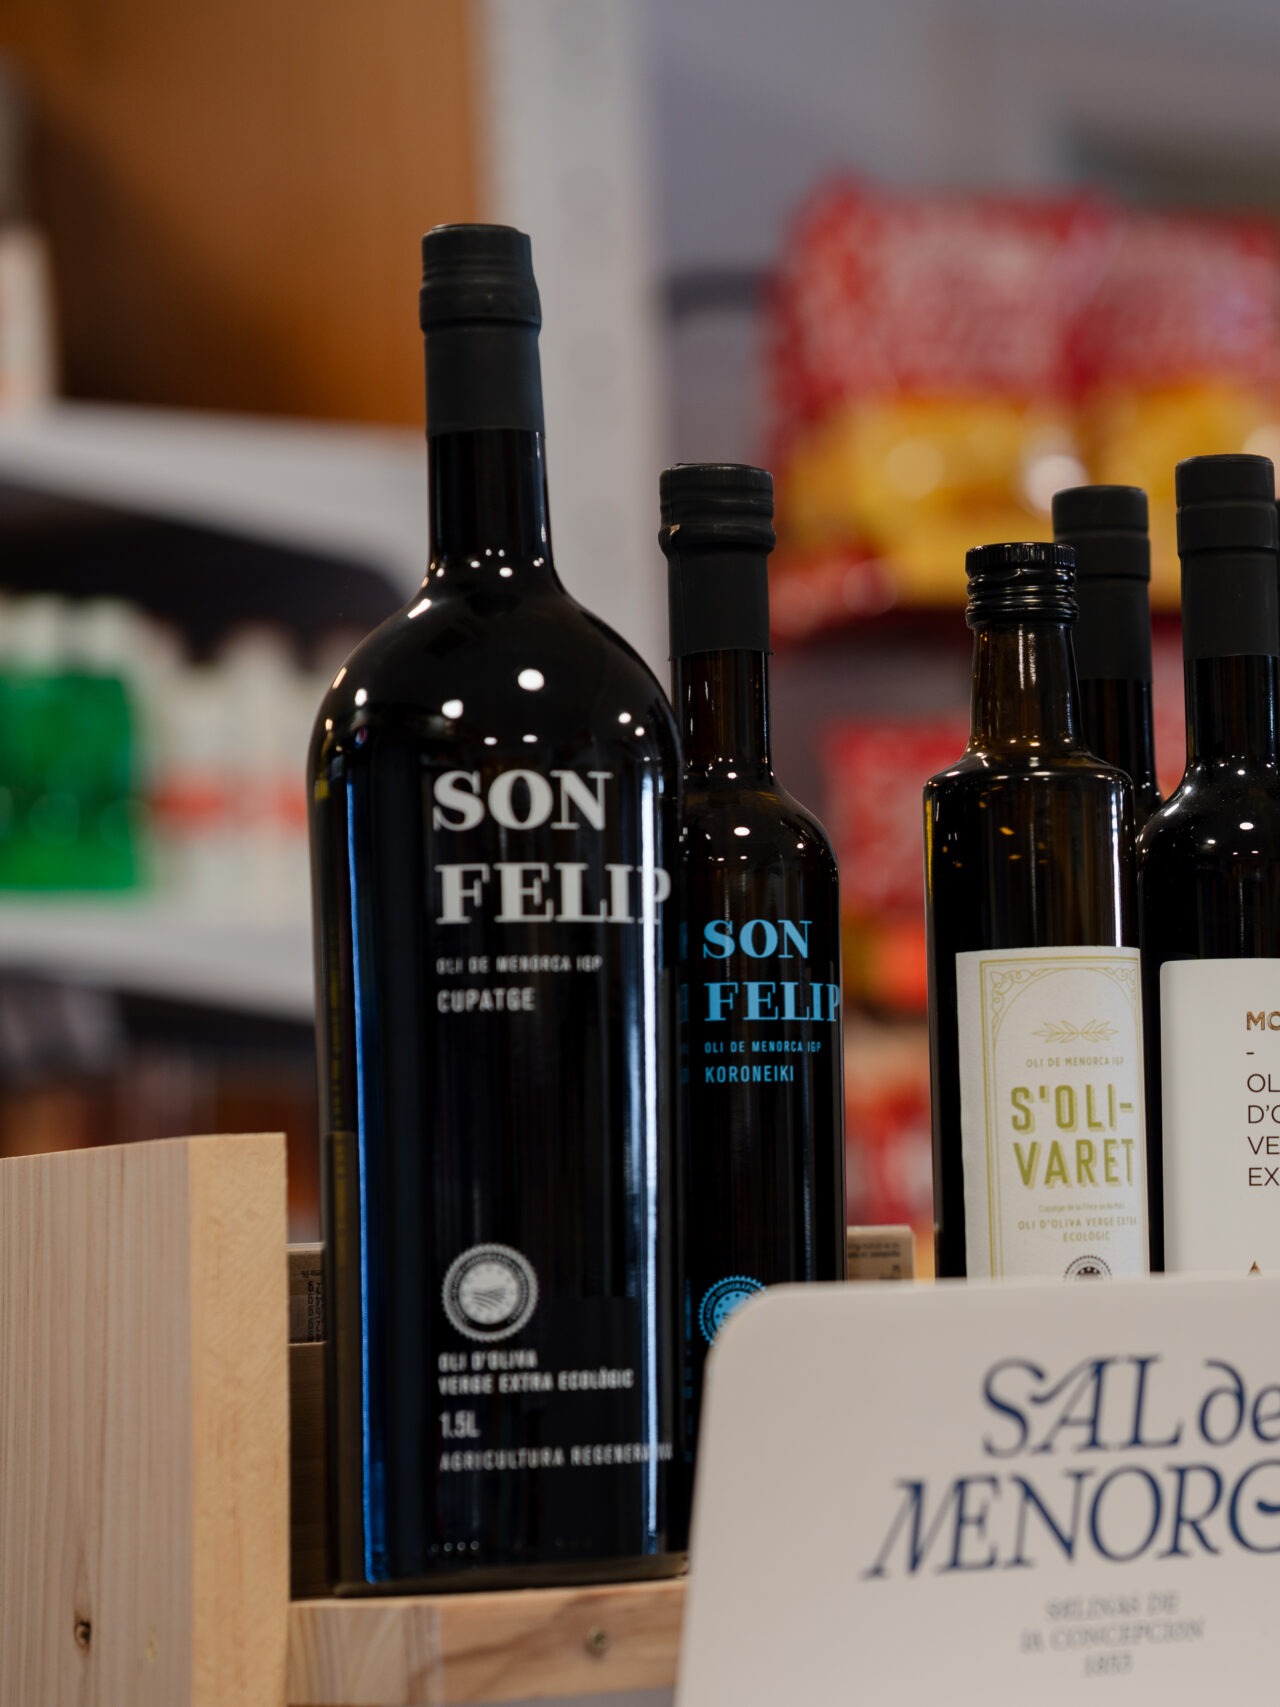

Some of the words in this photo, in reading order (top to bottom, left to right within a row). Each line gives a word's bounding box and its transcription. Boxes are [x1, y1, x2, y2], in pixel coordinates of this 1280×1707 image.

[433, 769, 613, 831] SON
[434, 862, 671, 925] FELIP
[703, 919, 812, 959] SON
[436, 957, 463, 974] OLI
[468, 956, 489, 973] DE
[496, 954, 571, 972] MENORCA
[437, 987, 535, 1013] CUPATGE
[703, 982, 840, 1021] FELIP
[704, 1041, 723, 1053] OLI
[731, 1041, 743, 1053] DE
[751, 1040, 803, 1053] MENORCA
[807, 1041, 822, 1052] IGP
[705, 1065, 794, 1083] KORONEIKI
[1025, 1058, 1043, 1068] OLI
[1047, 1057, 1060, 1067] DE
[1065, 1056, 1109, 1066] MENORCA
[1010, 1084, 1135, 1134] S'OLI-
[1012, 1138, 1136, 1190] VARET
[1017, 1220, 1035, 1230] OLI
[1040, 1218, 1082, 1229] D'OLIVA
[1086, 1216, 1114, 1227] VERGE
[438, 1352, 467, 1372] OLI
[439, 1374, 495, 1395] VERGE
[499, 1372, 553, 1393] EXTRA
[981, 1354, 1186, 1460] SAL
[440, 1447, 565, 1471] AGRICULTURA
